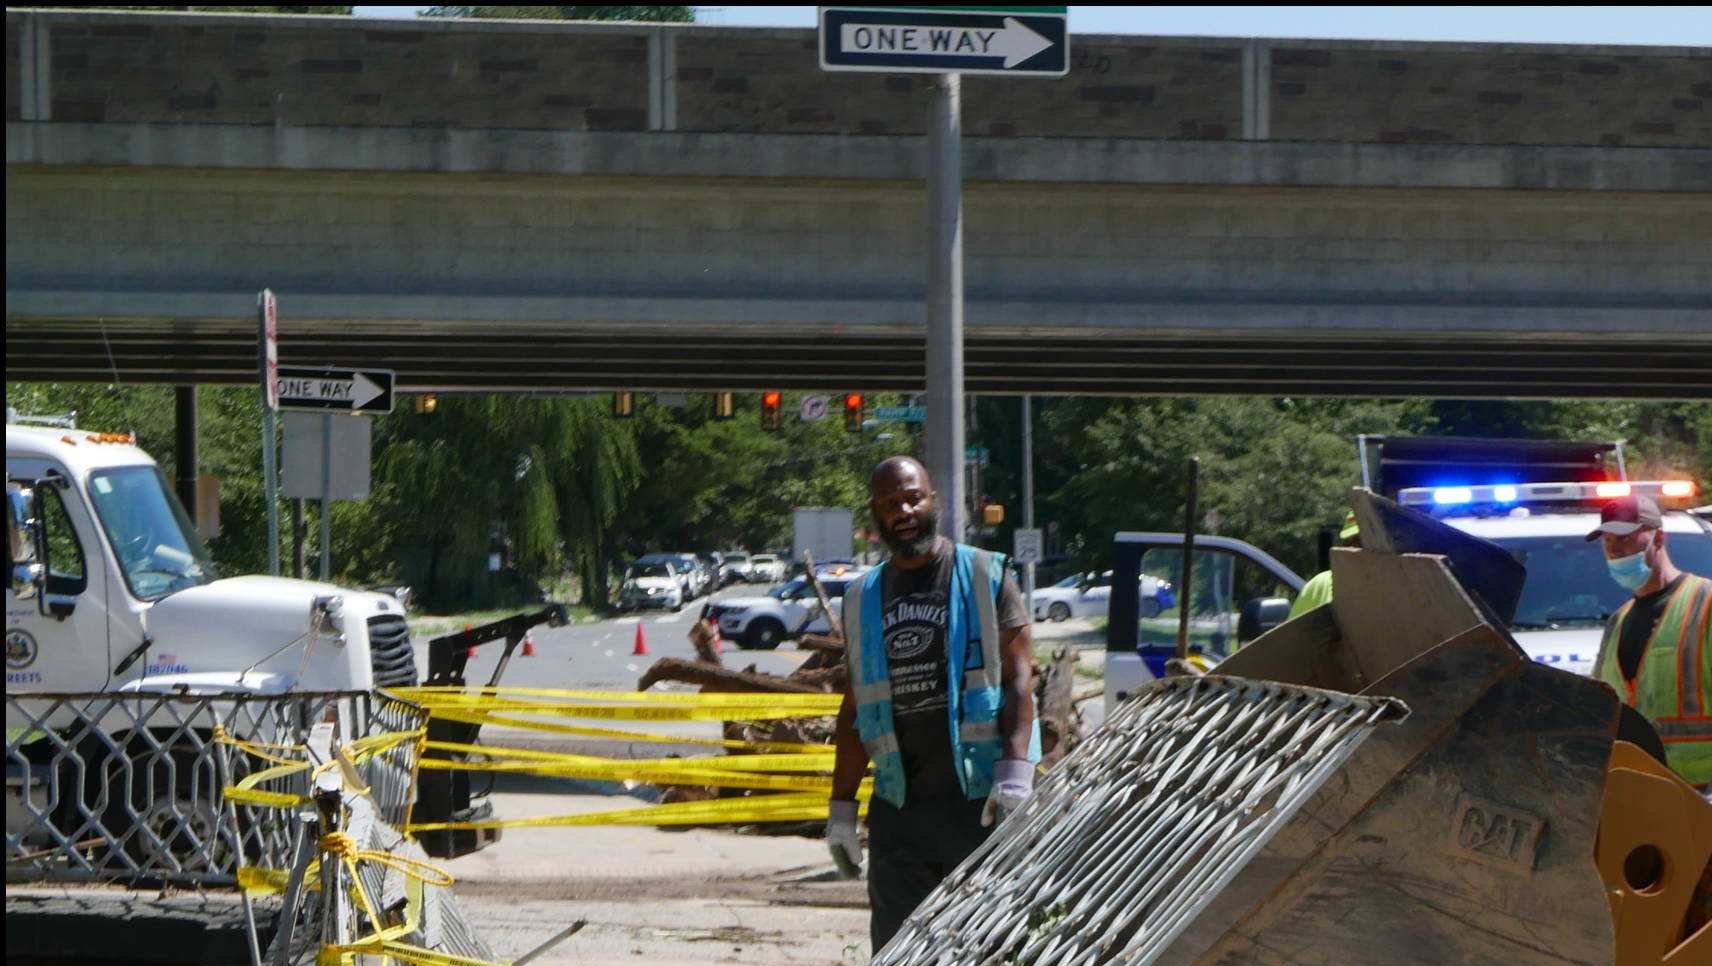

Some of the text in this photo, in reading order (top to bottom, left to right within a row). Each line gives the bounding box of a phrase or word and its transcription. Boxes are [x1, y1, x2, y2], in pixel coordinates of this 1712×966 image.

[854, 27, 996, 53] ONE WAY
[278, 380, 353, 398] ONE WAY
[1459, 807, 1530, 859] CAT
